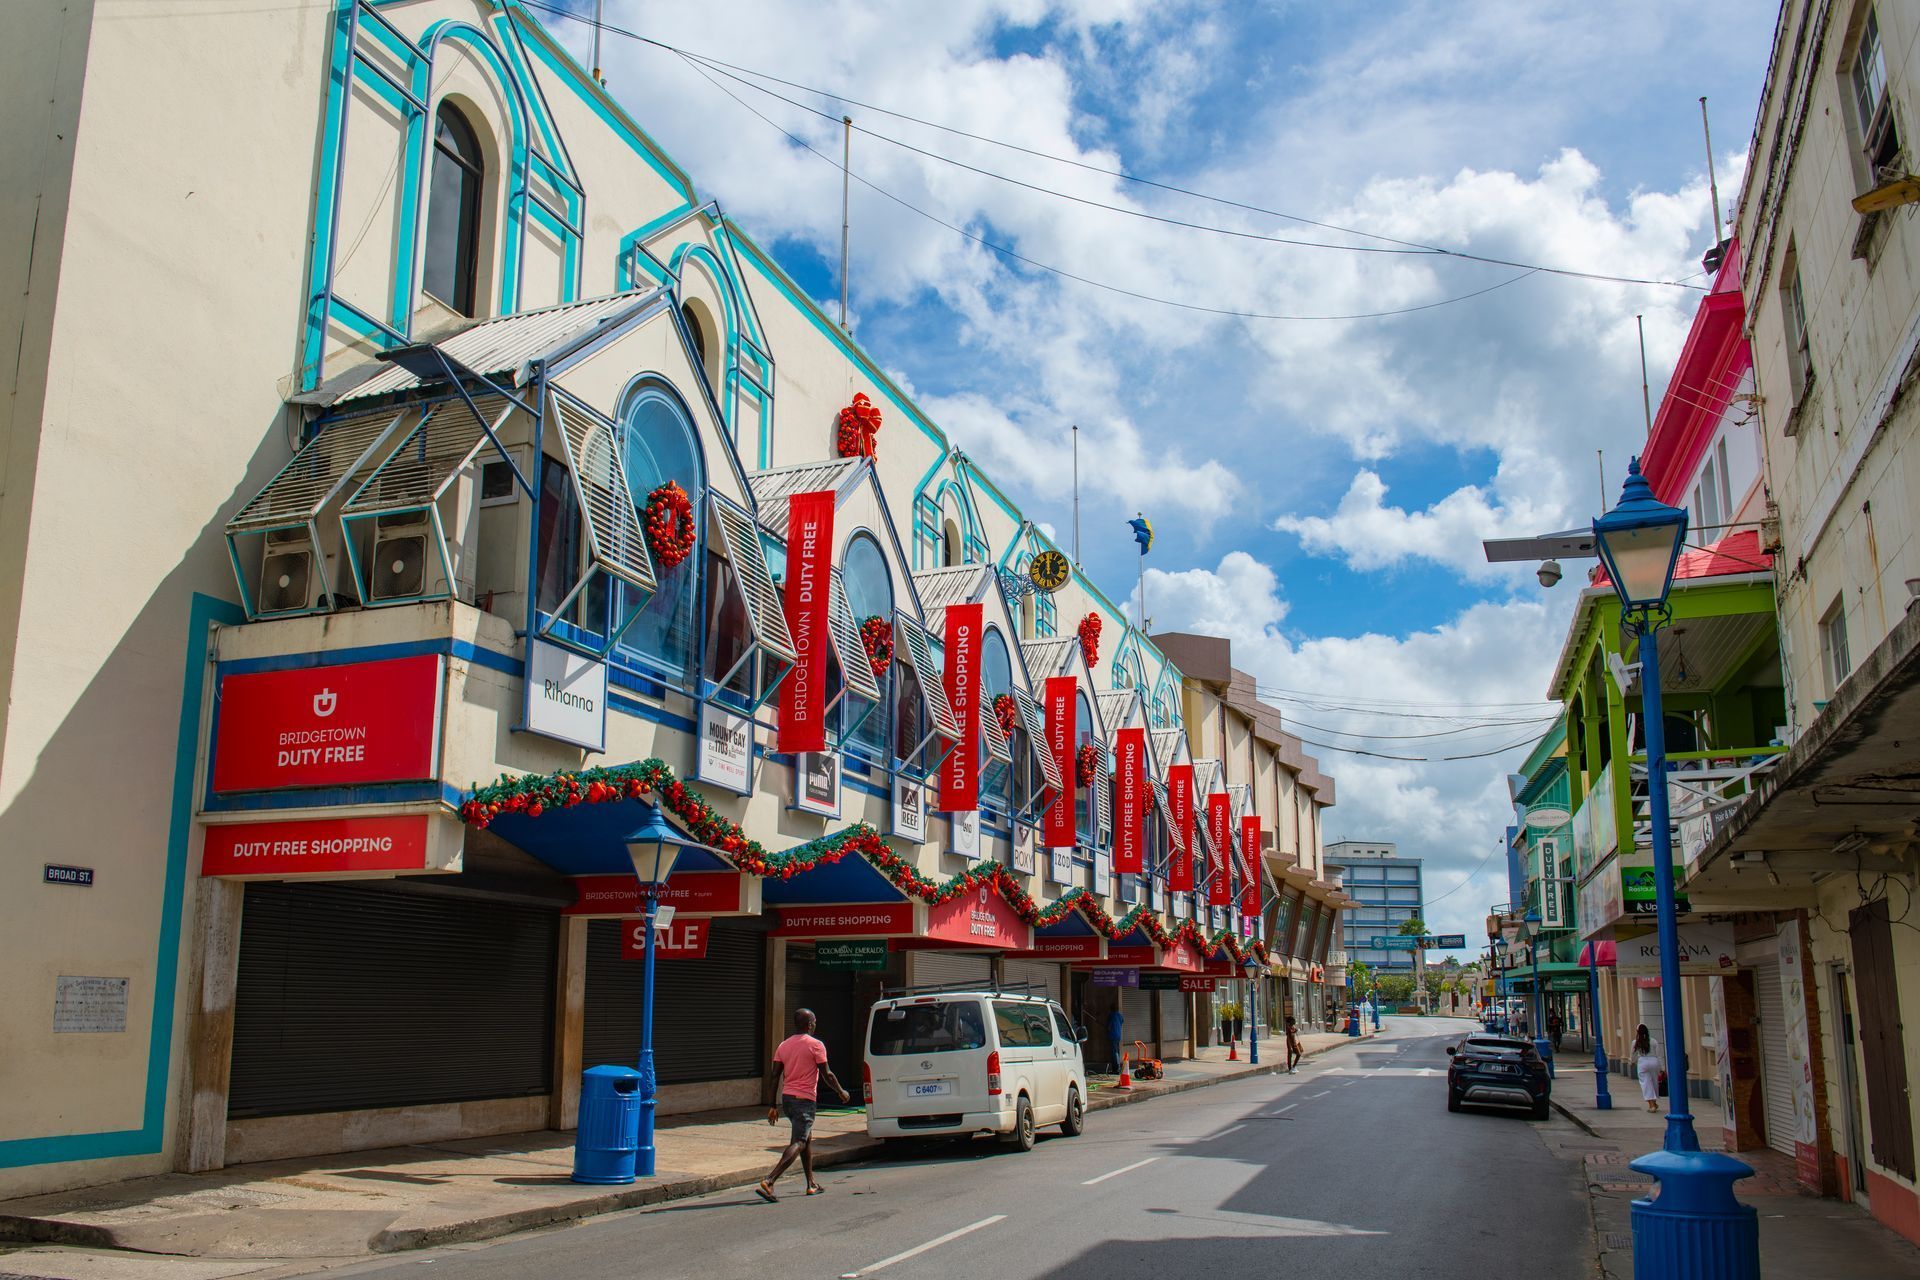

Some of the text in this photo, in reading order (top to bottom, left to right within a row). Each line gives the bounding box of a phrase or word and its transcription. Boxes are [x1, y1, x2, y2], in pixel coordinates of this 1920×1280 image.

[794, 521, 817, 721] BRIDGETOWN DUTY FREE
[954, 625, 969, 707] SHOPPING
[544, 678, 594, 713] Rihanna
[1056, 696, 1065, 720] FREE
[279, 726, 366, 745] BRIDGETOWN
[709, 722, 746, 748] MOUNT GAY
[1056, 722, 1065, 750] DUTY
[278, 745, 364, 767] DUTY FREE
[715, 740, 728, 756] 1703
[952, 751, 966, 790] DUTY
[809, 772, 829, 790] PUMA
[1124, 743, 1134, 858] DUTY FREE SHOPPING
[902, 811, 918, 829] REEF
[233, 837, 392, 857] DUTY FREE SHOPPING
[1014, 849, 1032, 870] ROXY
[1054, 852, 1071, 868] IZOD
[1545, 847, 1553, 878] DUTY
[48, 867, 92, 883] BROAD ST.
[586, 890, 638, 900] BRIDGETOWN
[670, 889, 690, 898] FREE
[786, 914, 891, 927] DUTY FREE SHOPPING
[970, 923, 996, 937] DUTY FREE
[632, 926, 699, 950] SALE
[818, 946, 852, 955] COLOMBIAN
[1640, 945, 1711, 956] ROANA
[1183, 979, 1210, 989] SALE
